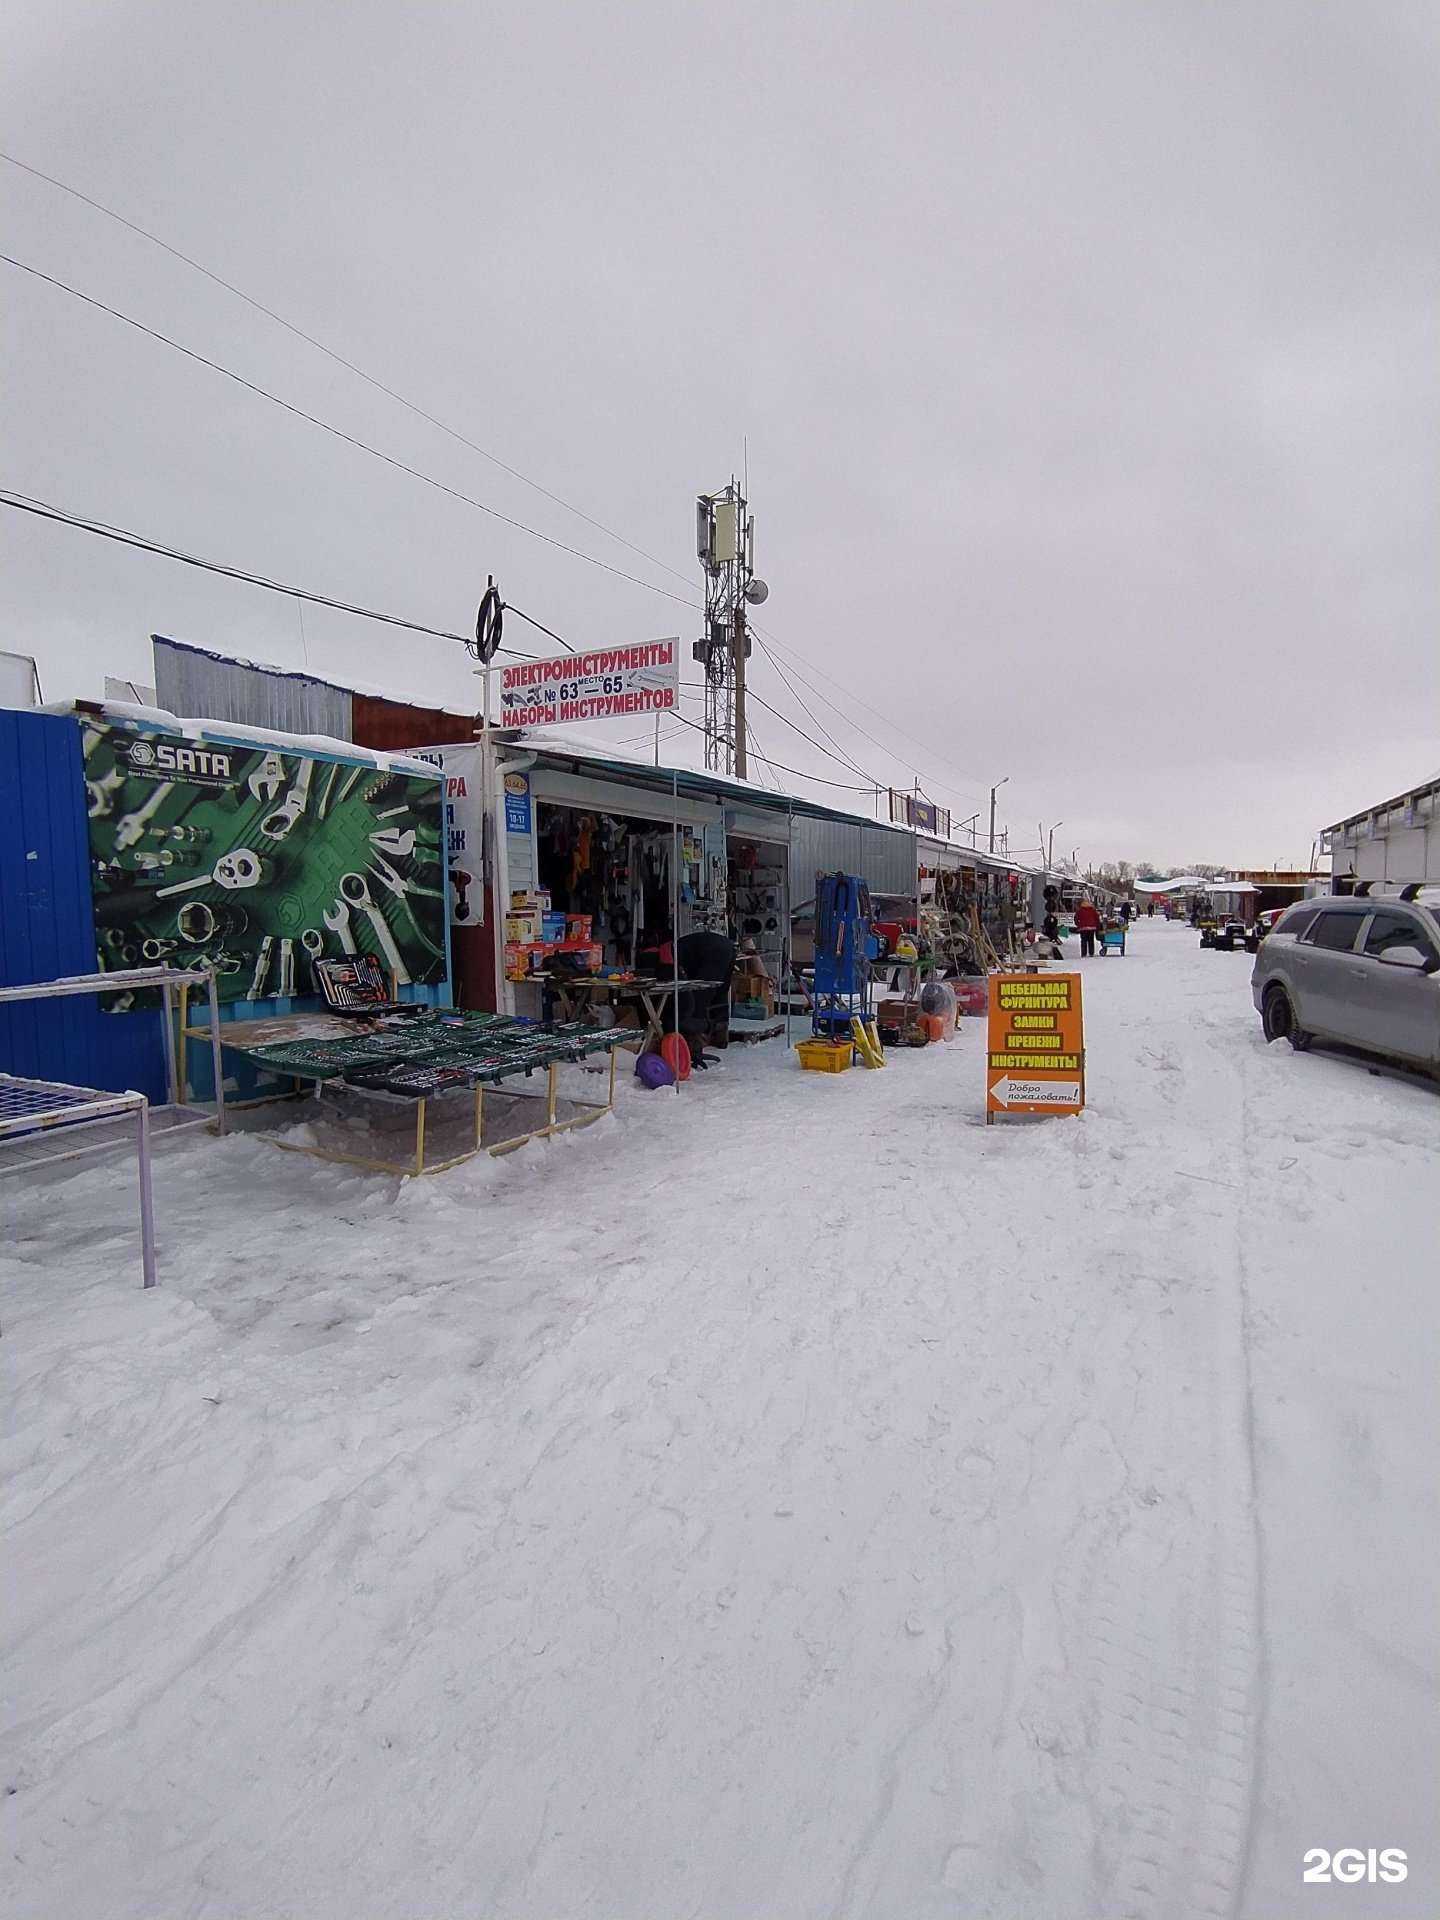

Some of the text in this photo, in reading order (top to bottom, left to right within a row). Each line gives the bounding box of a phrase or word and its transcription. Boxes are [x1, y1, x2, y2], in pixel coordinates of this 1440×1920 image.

[503, 642, 673, 689] ЭЛЕКТРОИНСТРУМЕНТЫ
[578, 675, 604, 686] МЕСТО
[559, 682, 579, 701] 63
[603, 676, 623, 695] 65
[503, 688, 674, 728] НАБОРЫ ИНСТРУМЕНТОВ
[156, 745, 231, 777] SATA
[1000, 983, 1068, 996] МЕБЕЛЬНАЯ
[1000, 996, 1068, 1009] ФУРНИТУРА
[1014, 1015, 1054, 1028] ЗАМКИ
[1007, 1035, 1061, 1048] КРЕПЕЖИ
[991, 1055, 1078, 1068] ИНСТРУМЕНТЫ
[1008, 1083, 1041, 1093] Добро
[1008, 1088, 1079, 1102] пожаловать!
